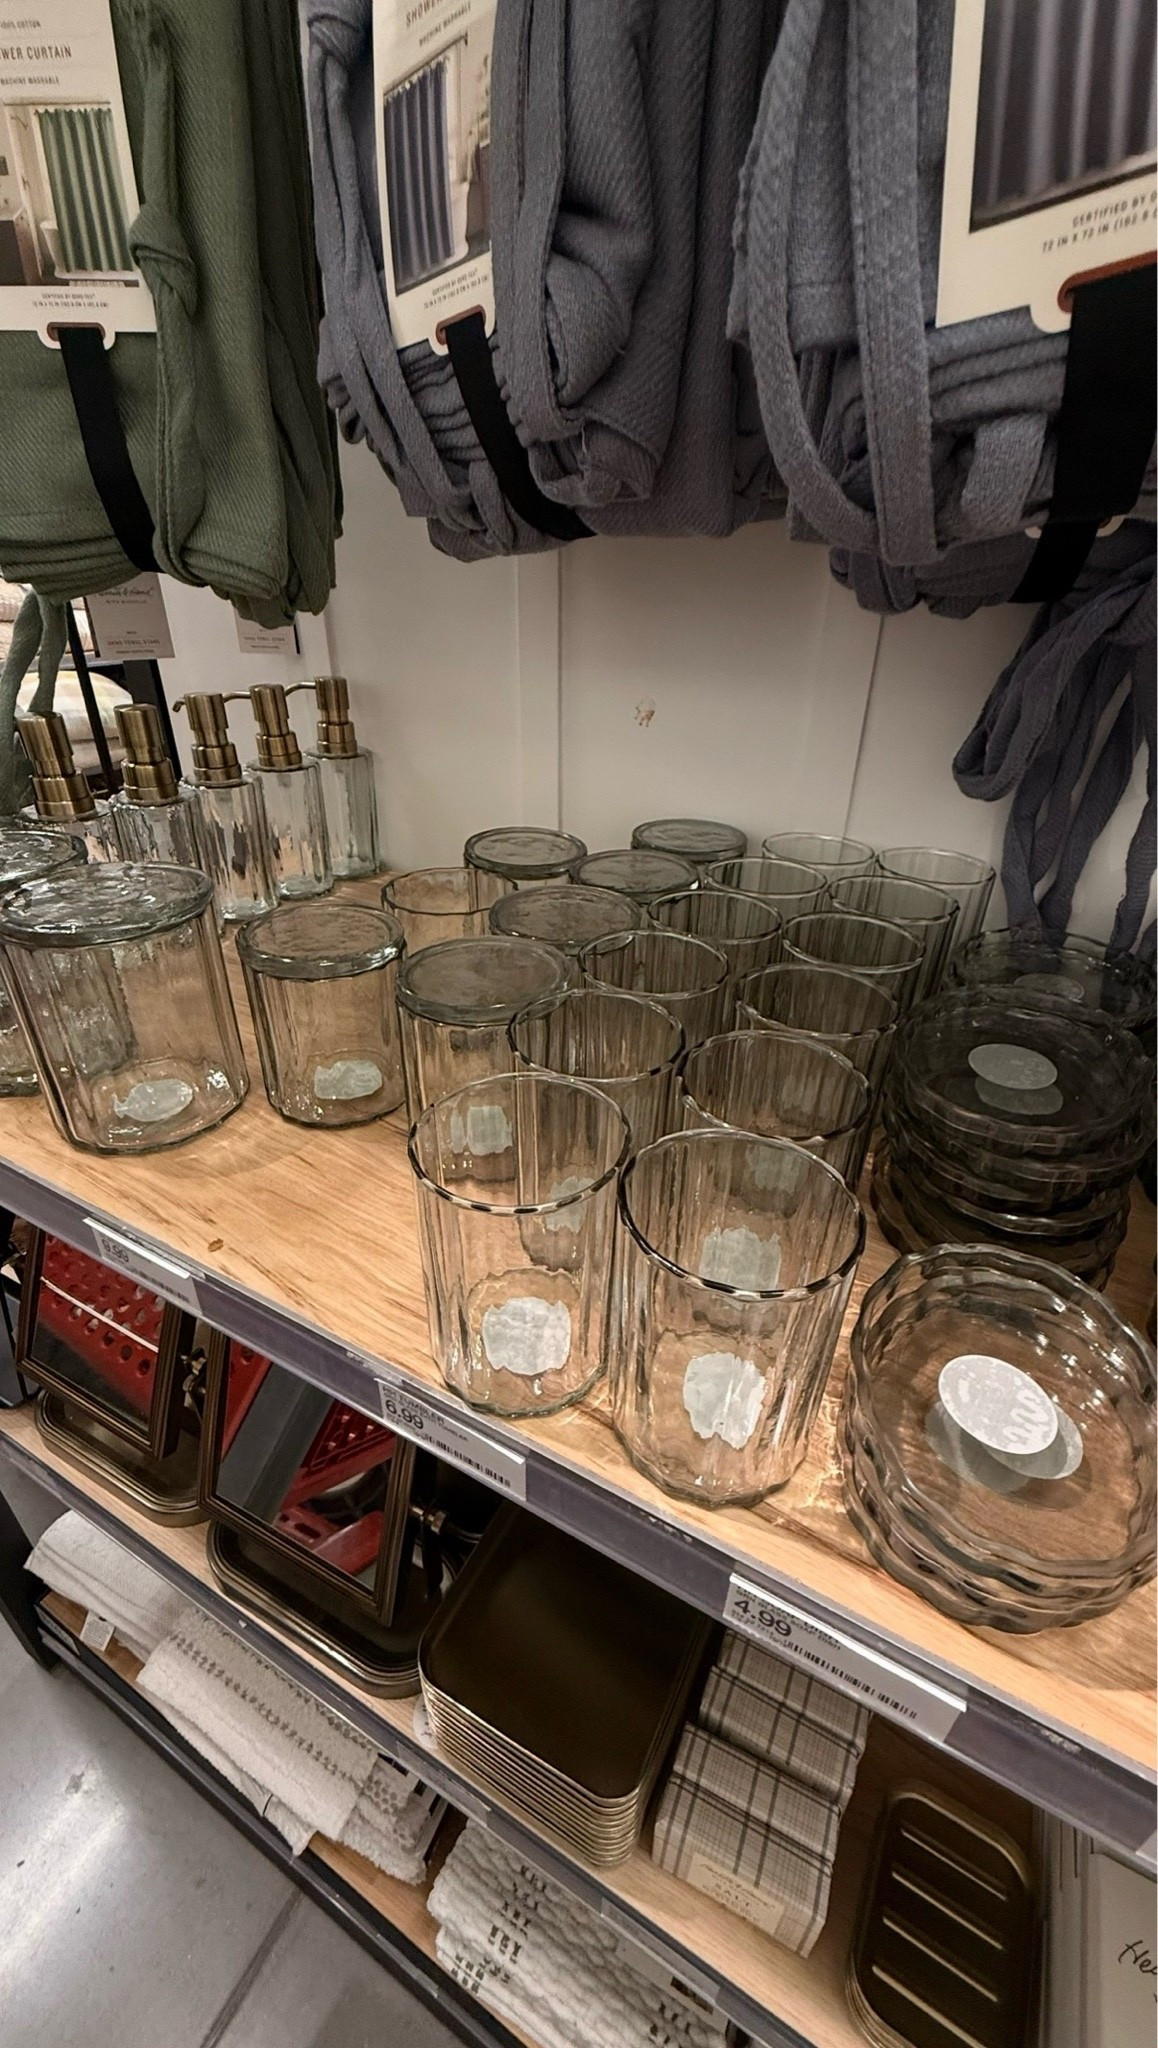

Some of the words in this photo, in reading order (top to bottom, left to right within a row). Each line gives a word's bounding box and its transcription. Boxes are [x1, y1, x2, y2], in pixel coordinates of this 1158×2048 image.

[405, 0, 440, 28] SHOWE
[0, 46, 24, 60] WER
[26, 45, 72, 60] CURTAIN
[1073, 200, 1128, 227] CERTIFIED
[1132, 193, 1146, 209] BY
[1042, 240, 1054, 253] 72
[1057, 235, 1068, 247] IN
[1083, 227, 1094, 240] 72
[1098, 222, 1109, 234] IN
[385, 1400, 424, 1430] 6.99
[734, 1600, 791, 1637] 4.99
